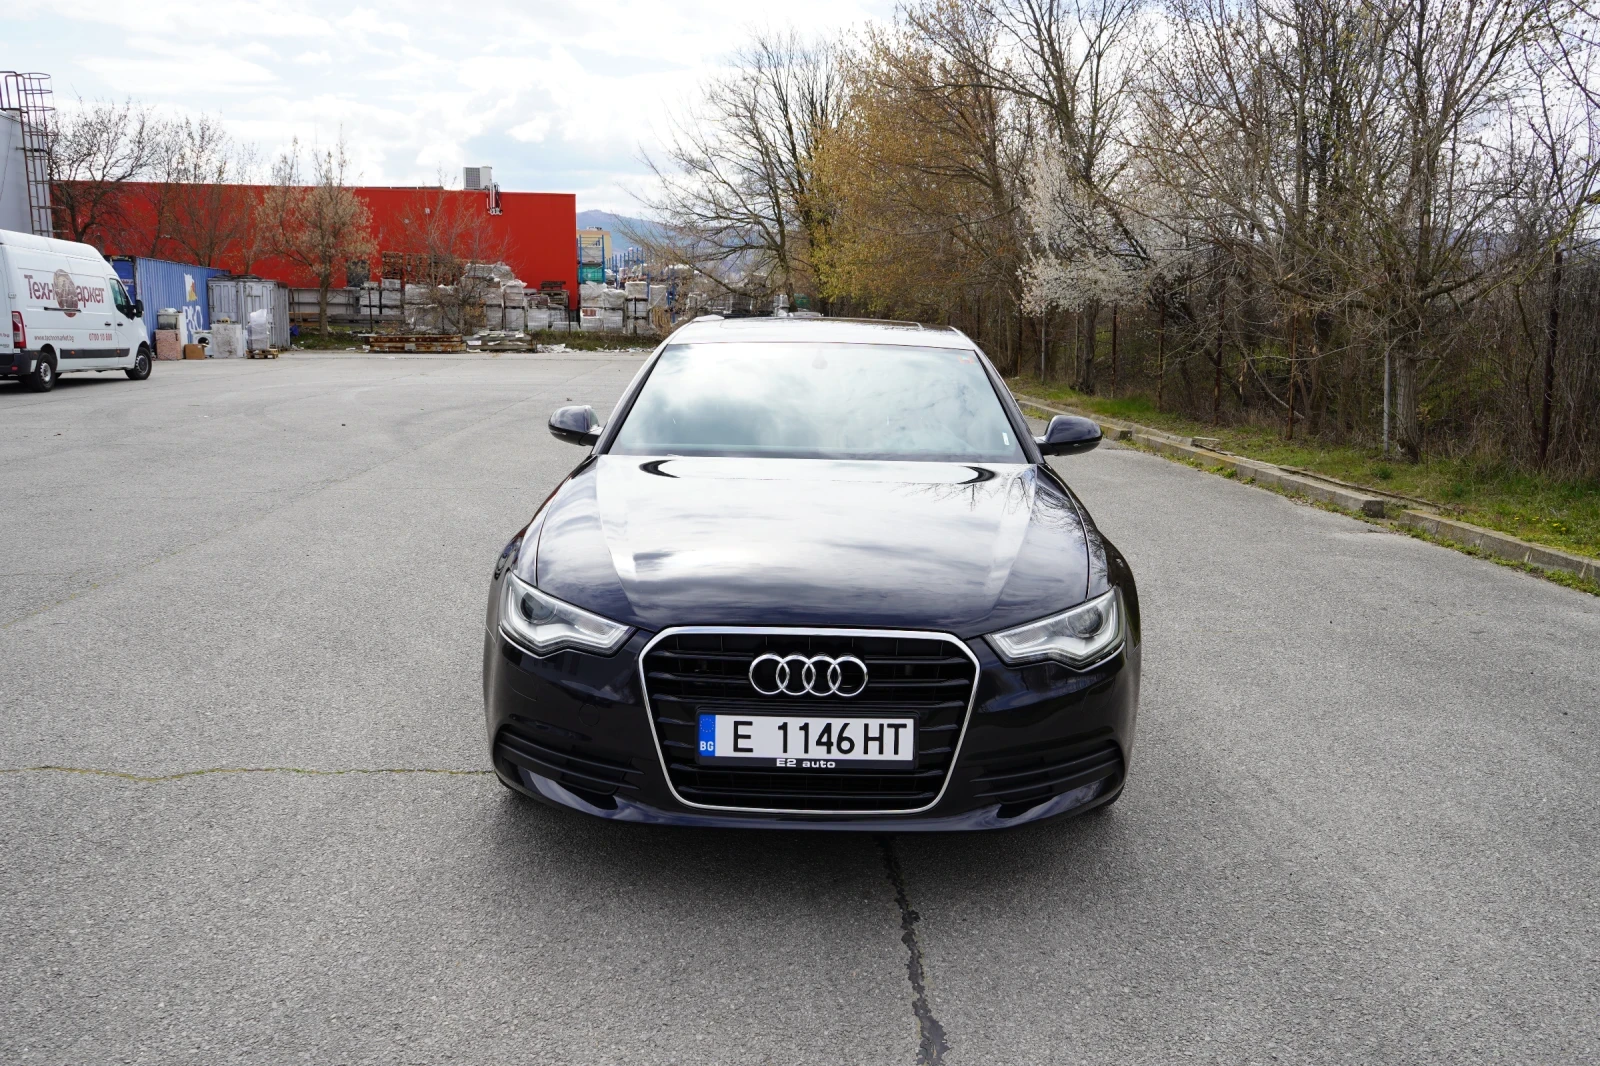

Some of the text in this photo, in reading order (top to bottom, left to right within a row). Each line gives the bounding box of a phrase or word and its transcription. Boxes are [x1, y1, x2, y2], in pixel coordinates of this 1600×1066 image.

[733, 720, 754, 753] E
[700, 741, 714, 751] BG
[776, 758, 836, 769] E2 auto
